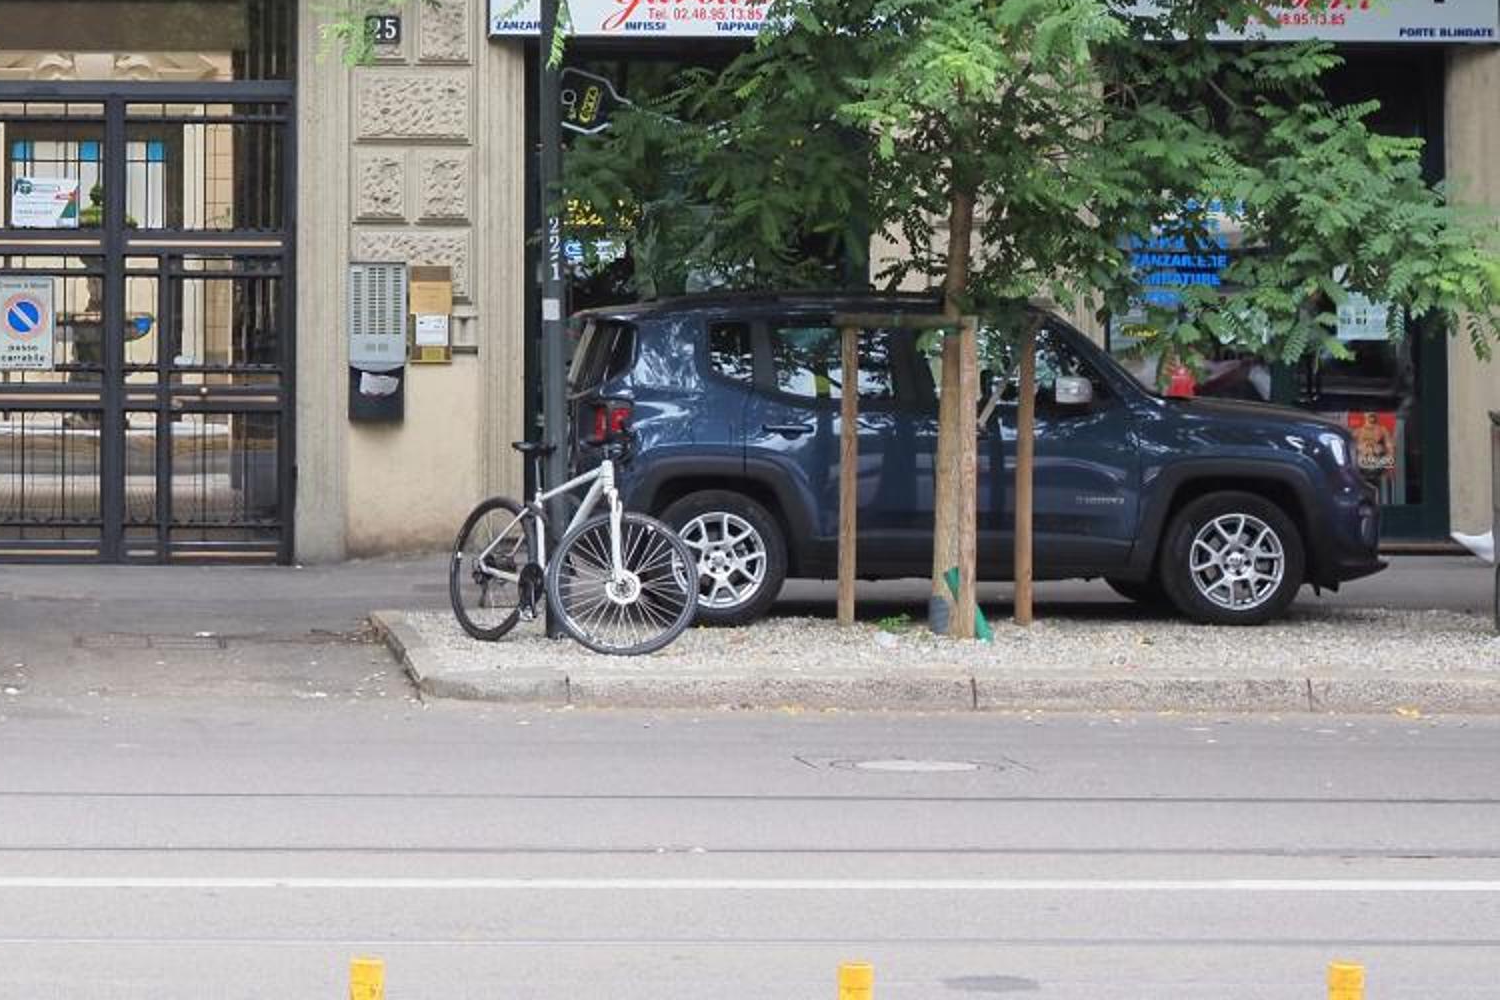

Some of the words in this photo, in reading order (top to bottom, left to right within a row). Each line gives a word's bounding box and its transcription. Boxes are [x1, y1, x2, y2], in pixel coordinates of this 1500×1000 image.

[369, 18, 397, 39] 25
[625, 21, 667, 31] INFISSI
[1399, 27, 1437, 38] PORTE
[1440, 28, 1495, 38] BLINDATE
